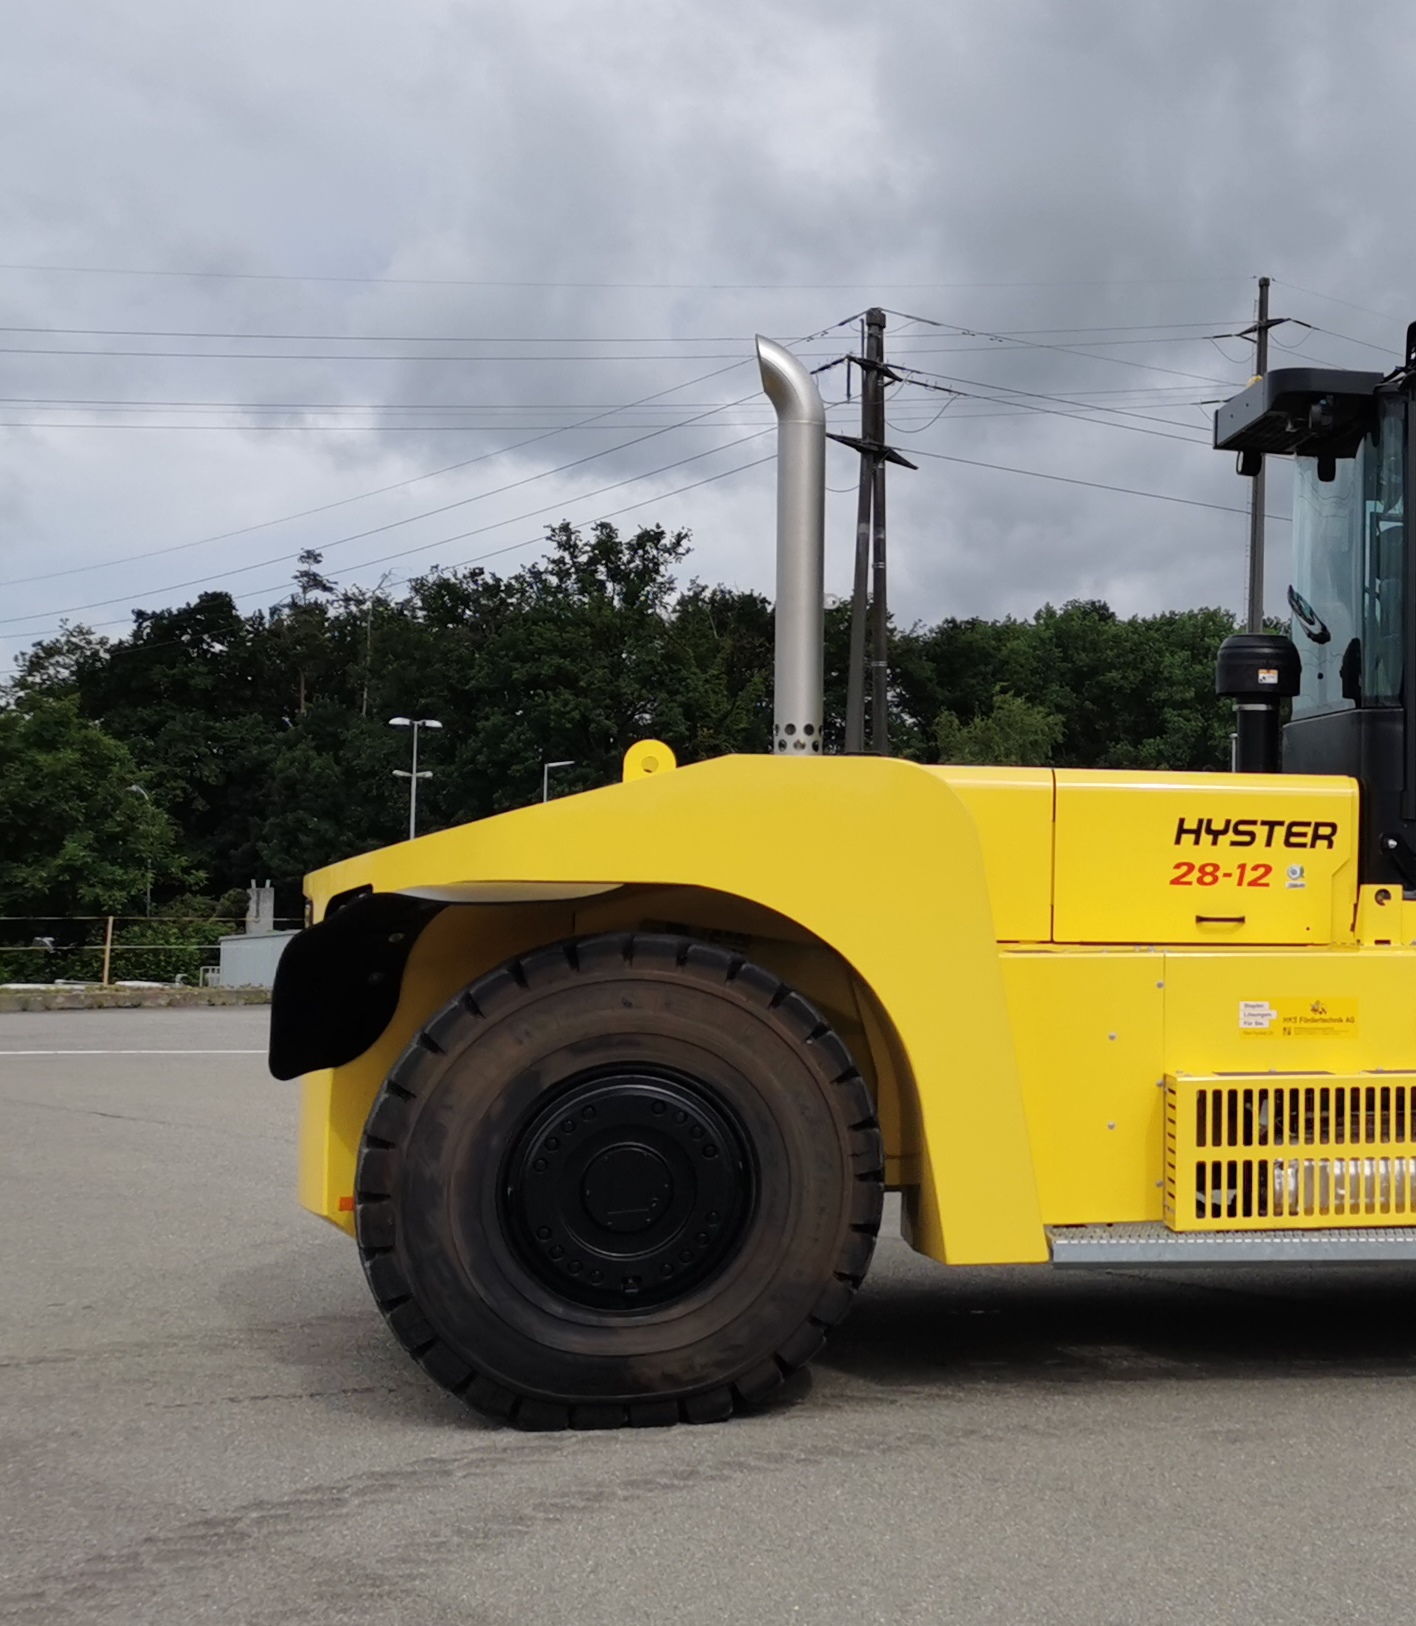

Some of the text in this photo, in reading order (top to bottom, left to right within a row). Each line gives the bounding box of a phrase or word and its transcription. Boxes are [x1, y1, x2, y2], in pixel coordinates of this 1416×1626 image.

[1174, 817, 1338, 850] HYSTER
[1169, 861, 1273, 888] 28-12
[1299, 1016, 1344, 1024] Fördertechnik
[1346, 1016, 1355, 1024] AG
